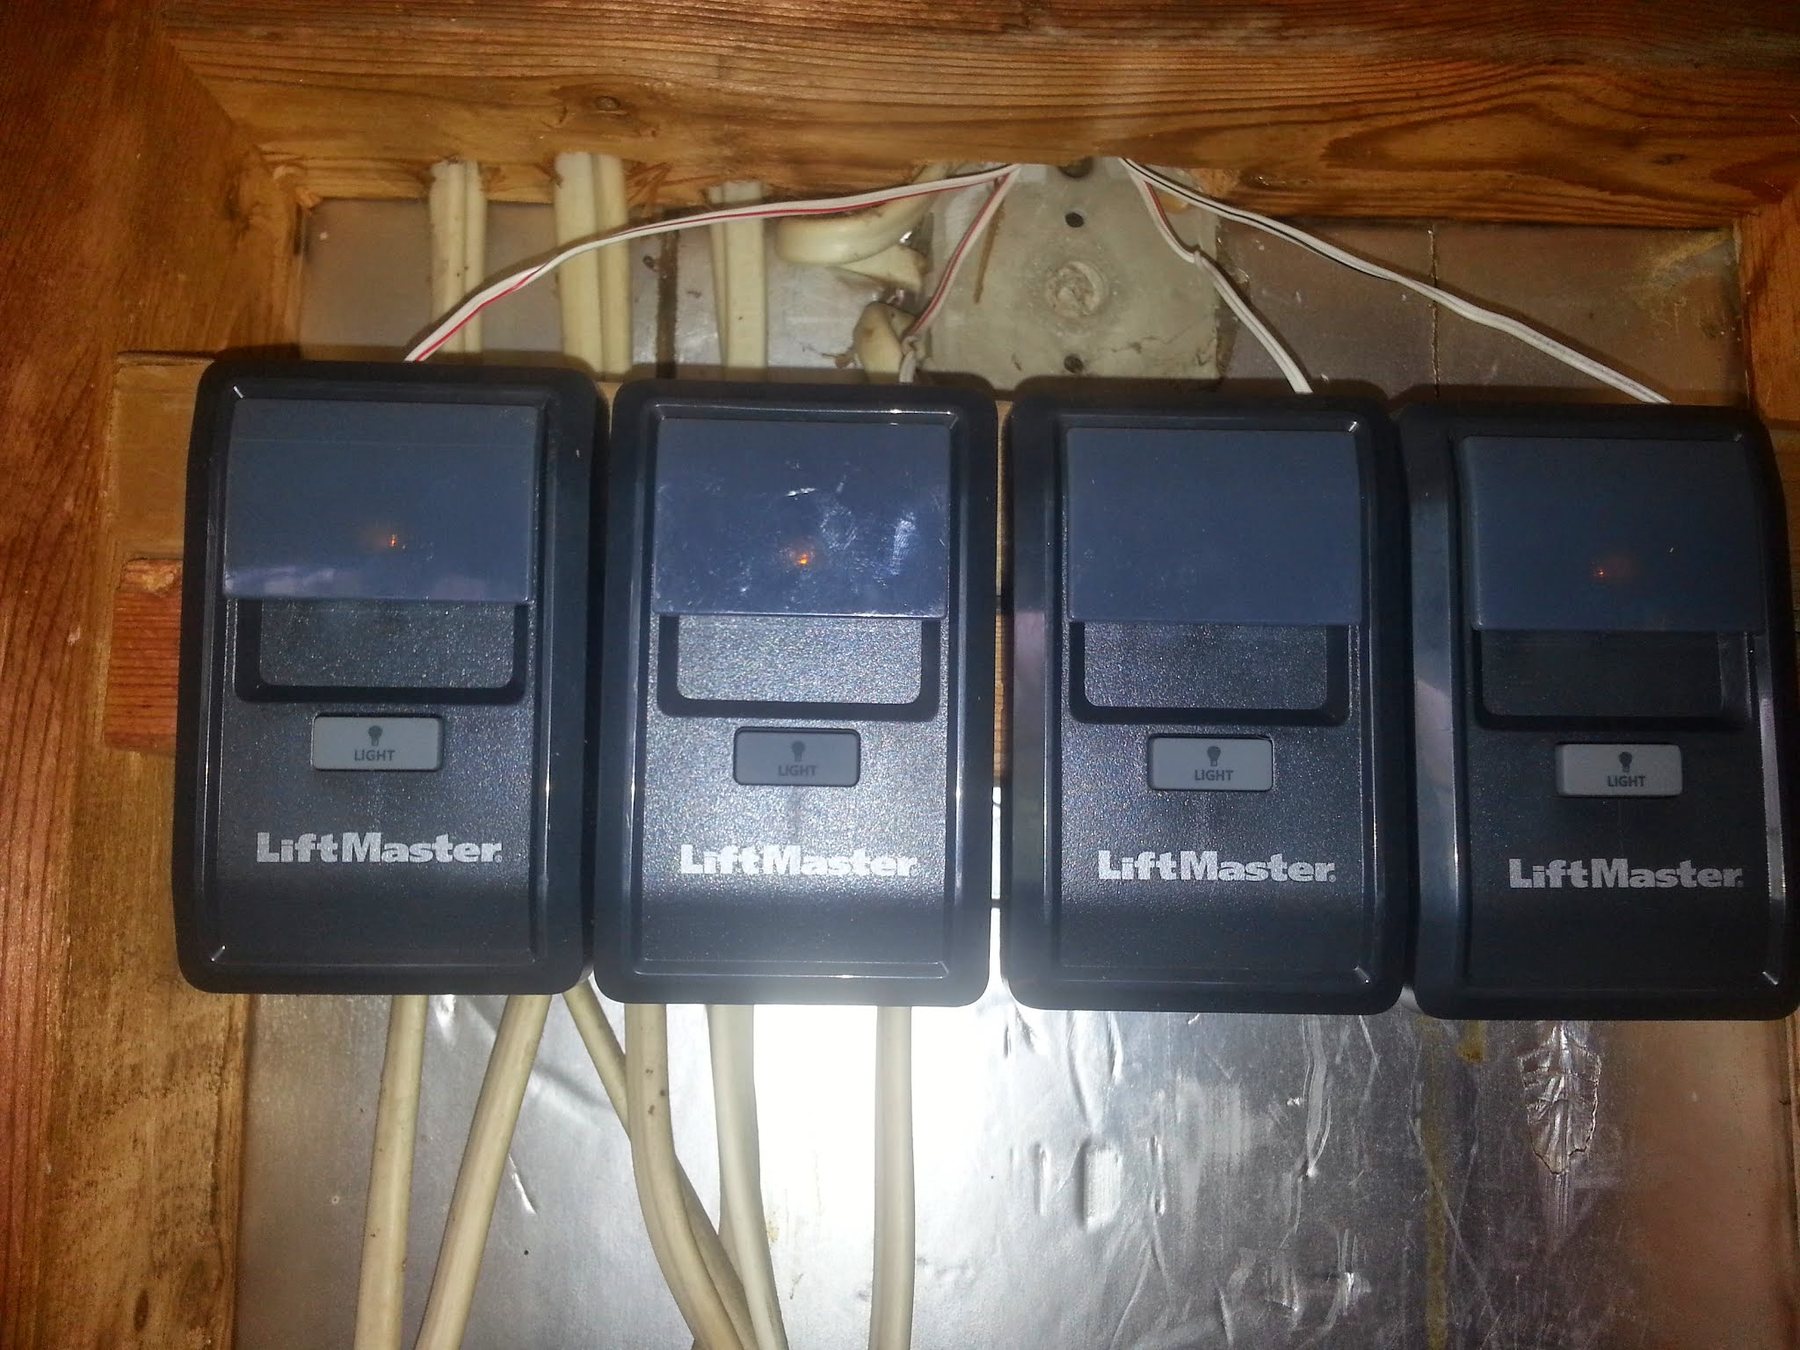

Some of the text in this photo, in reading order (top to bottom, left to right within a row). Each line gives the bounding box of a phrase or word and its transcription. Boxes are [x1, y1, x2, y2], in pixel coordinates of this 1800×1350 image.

[354, 749, 396, 762] LIGHT
[778, 764, 817, 777] LIGHT
[1194, 769, 1234, 781] LIGHT
[1607, 775, 1646, 787] LIGHT
[256, 831, 503, 864] LiftMaster
[680, 844, 918, 877] LiftMaster
[1098, 850, 1337, 883] LiftMaster
[1509, 858, 1744, 889] LiftMaster
